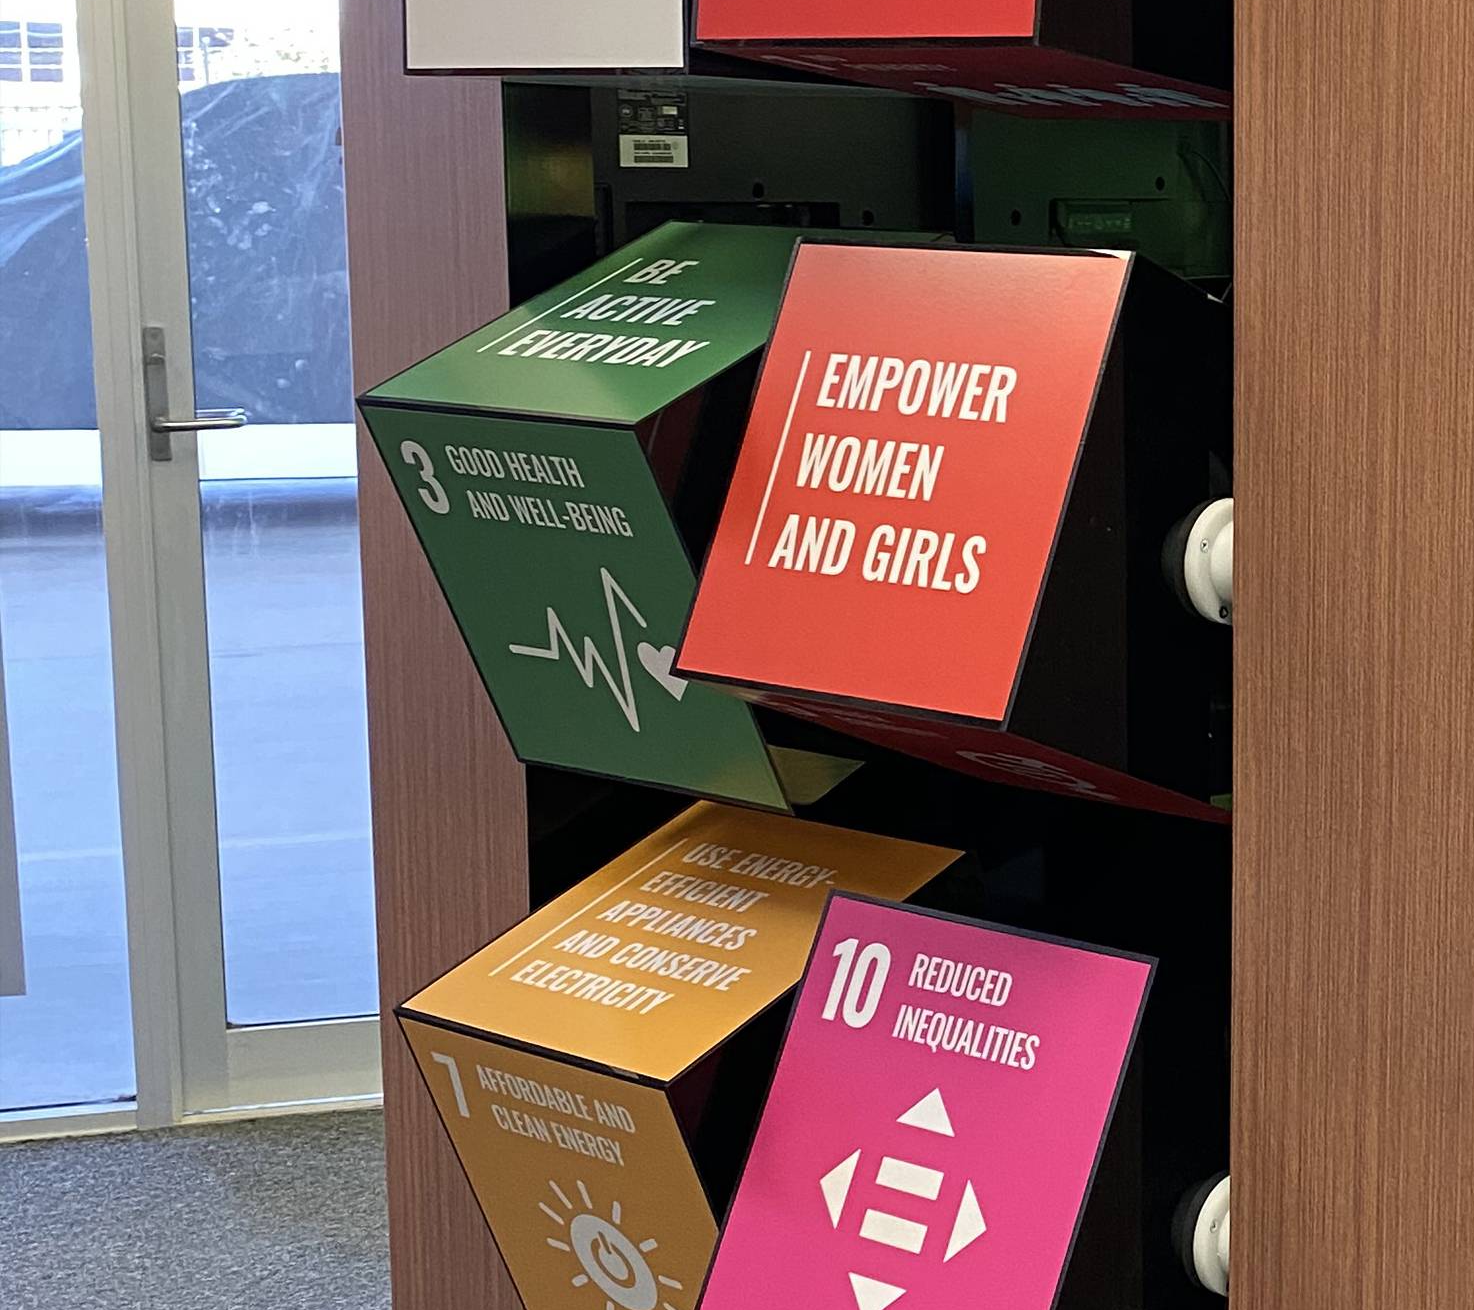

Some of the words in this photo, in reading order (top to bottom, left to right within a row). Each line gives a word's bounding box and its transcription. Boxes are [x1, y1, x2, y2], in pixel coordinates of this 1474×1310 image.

[624, 258, 698, 286] BE
[562, 293, 716, 327] ACTIVE
[505, 329, 710, 368] EVERYDAY
[816, 352, 1018, 424] EMPOWER
[400, 439, 450, 515] 3
[445, 445, 502, 482] GOOD
[505, 451, 585, 488] HEALTH
[795, 431, 944, 502] WOMEN
[468, 487, 510, 522] AND
[511, 492, 634, 538] WELL-BEING
[768, 512, 856, 577] AND
[862, 523, 988, 595] GIRLS
[641, 870, 769, 913] EFFICIENT
[684, 843, 735, 871] USE
[731, 849, 835, 891] ENERGY-
[596, 900, 757, 953] APPLIANCES
[510, 959, 674, 1016] ELECTRICITY
[554, 930, 615, 964] AND
[609, 943, 751, 993] CONSERVE
[822, 936, 892, 1030] 10
[908, 953, 1013, 1008] REDUCED
[891, 1003, 1042, 1072] INEQUALITIES
[432, 1051, 471, 1120] 7
[474, 1063, 594, 1124] AFFORDABLE
[591, 1098, 638, 1135] AND
[490, 1102, 556, 1147] CLEAN
[554, 1120, 625, 1168] ENERGY
